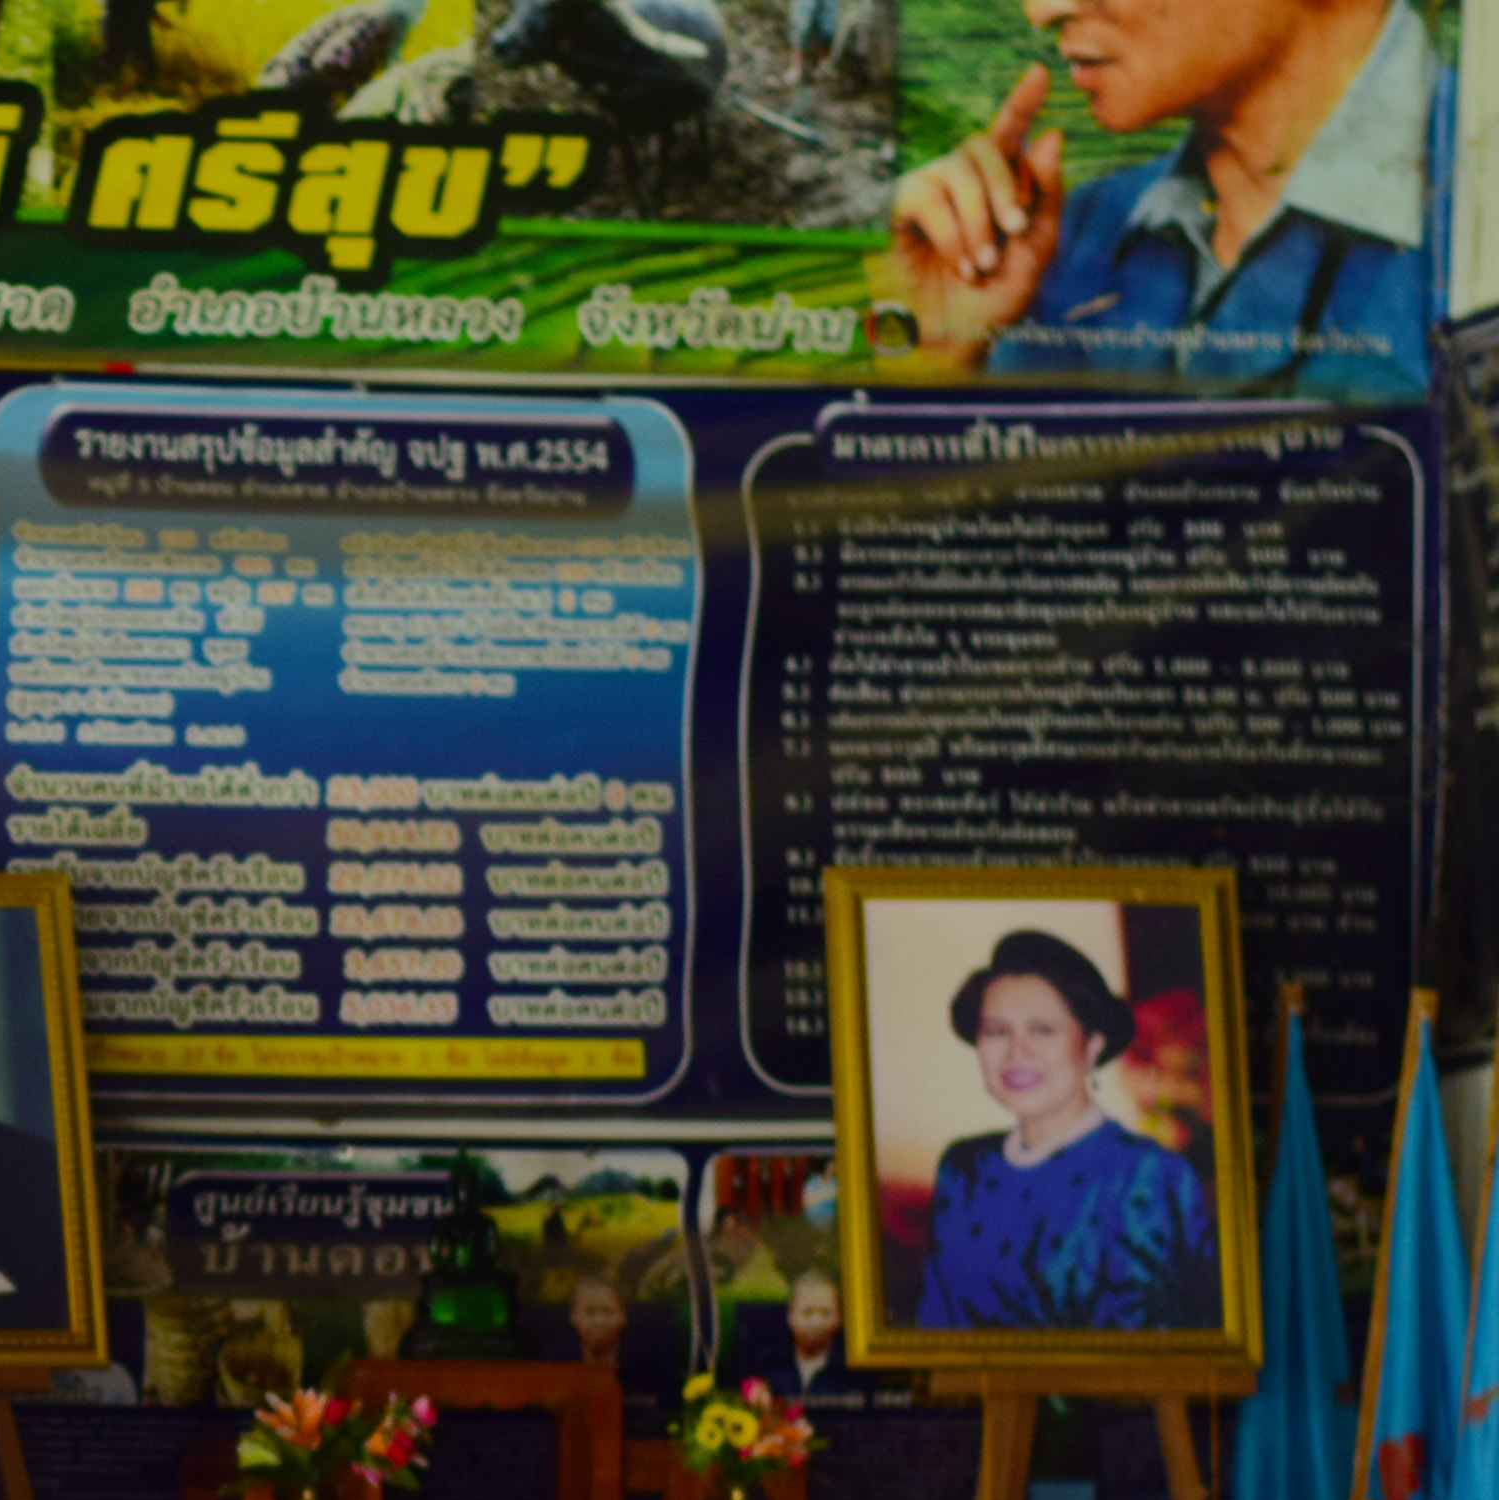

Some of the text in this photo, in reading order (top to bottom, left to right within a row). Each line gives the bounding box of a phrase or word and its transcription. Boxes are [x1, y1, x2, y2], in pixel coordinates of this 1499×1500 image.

[128, 270, 524, 346] อำเภอบ้านหลวง
[576, 284, 860, 353] จังหวัดน่าน
